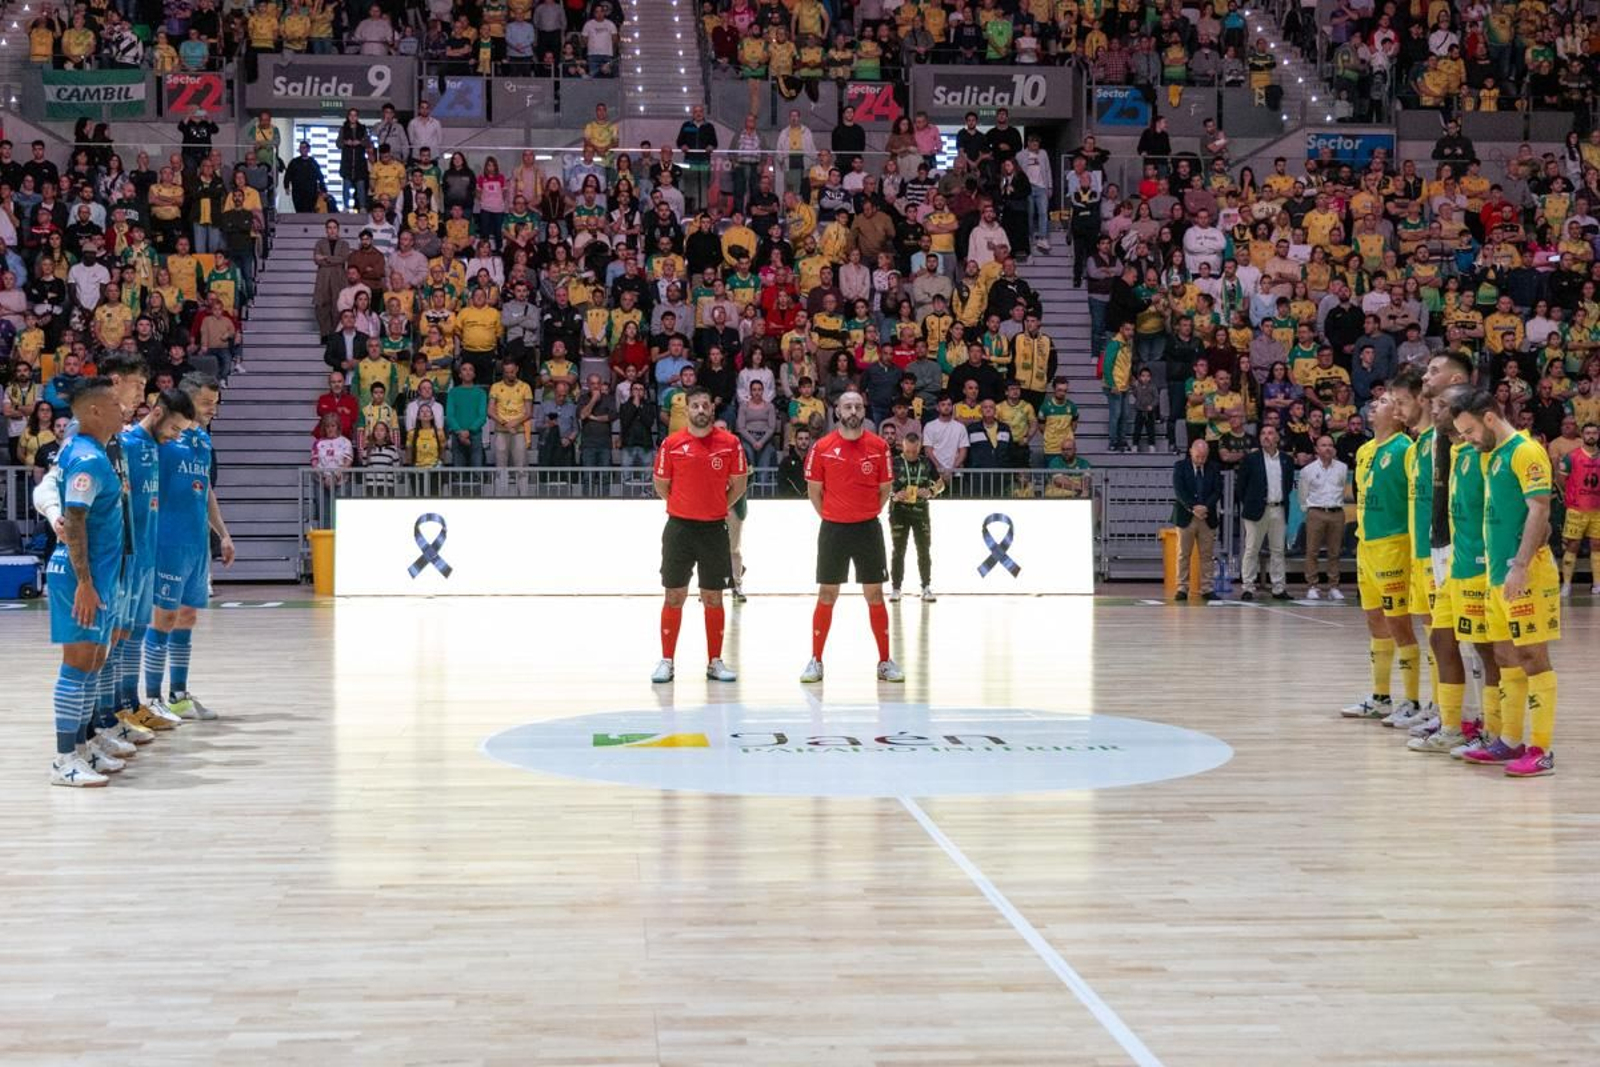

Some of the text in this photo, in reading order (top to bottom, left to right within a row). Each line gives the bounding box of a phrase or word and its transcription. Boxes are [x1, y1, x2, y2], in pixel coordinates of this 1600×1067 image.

[166, 74, 201, 85] Sector
[273, 64, 391, 97] Salida 9
[56, 87, 134, 101] CAMBIL
[166, 74, 224, 112] 22
[847, 84, 881, 94] Sector
[933, 74, 1046, 107] Salida 10
[1096, 89, 1130, 98] Sector
[847, 84, 901, 122] 24
[1306, 134, 1363, 150] Sector
